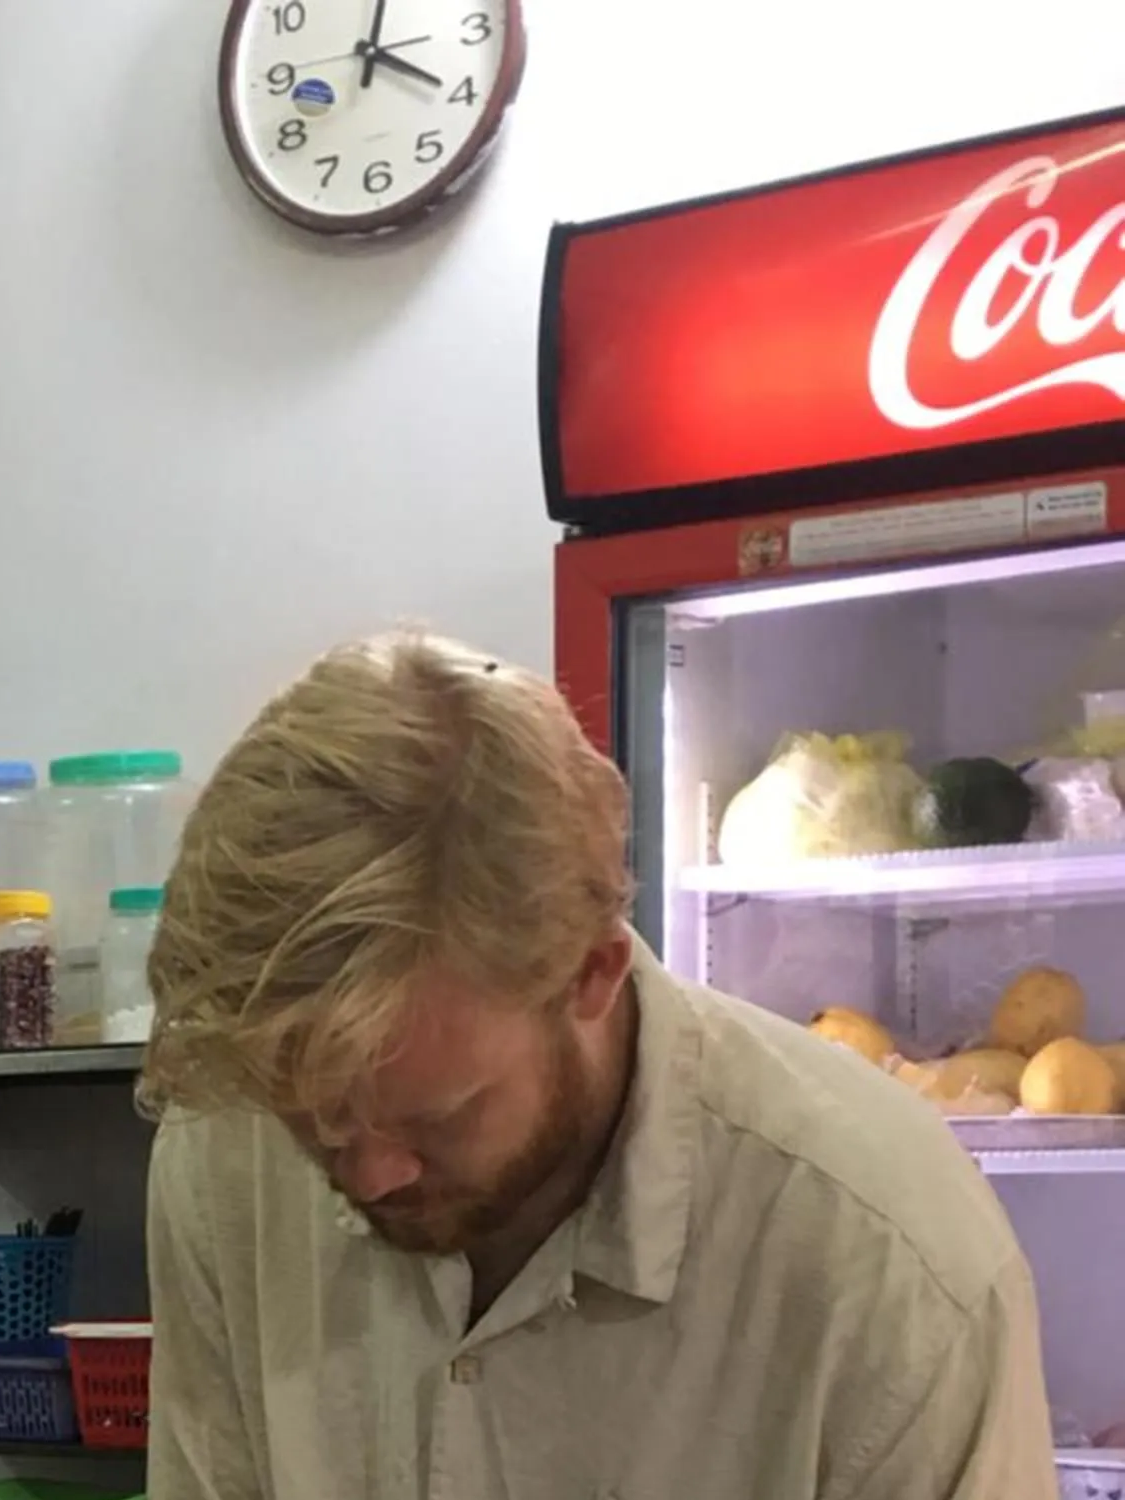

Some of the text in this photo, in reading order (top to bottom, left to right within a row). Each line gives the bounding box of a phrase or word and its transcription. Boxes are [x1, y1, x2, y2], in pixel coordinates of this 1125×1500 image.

[273, 0, 305, 35] 10
[460, 12, 492, 46] 3
[267, 62, 295, 96] 9
[446, 75, 479, 107] 4
[277, 118, 308, 152] 8
[414, 129, 444, 164] 5
[314, 155, 340, 188] 7
[362, 161, 394, 194] 6
[868, 156, 1125, 428] Coc
